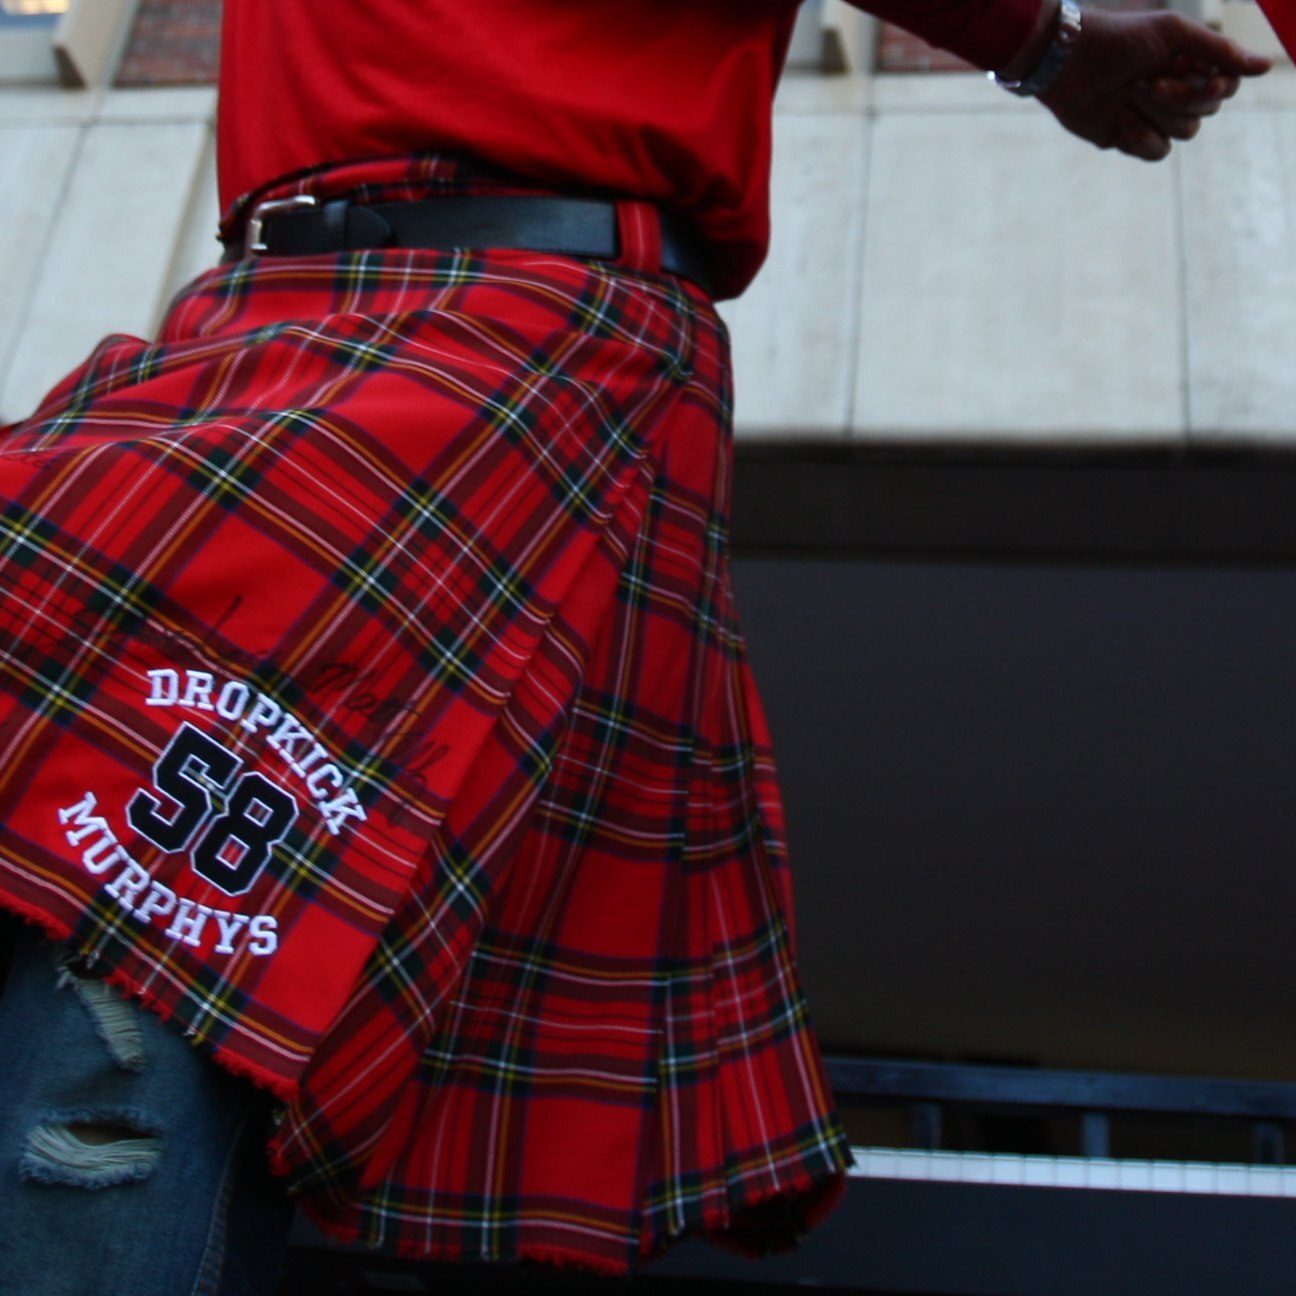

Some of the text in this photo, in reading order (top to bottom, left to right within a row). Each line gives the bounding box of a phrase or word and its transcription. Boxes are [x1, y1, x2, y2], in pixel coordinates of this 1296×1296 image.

[125, 721, 299, 897] 58
[146, 668, 367, 835] DROPKICK
[58, 792, 278, 956] MURPHYS
